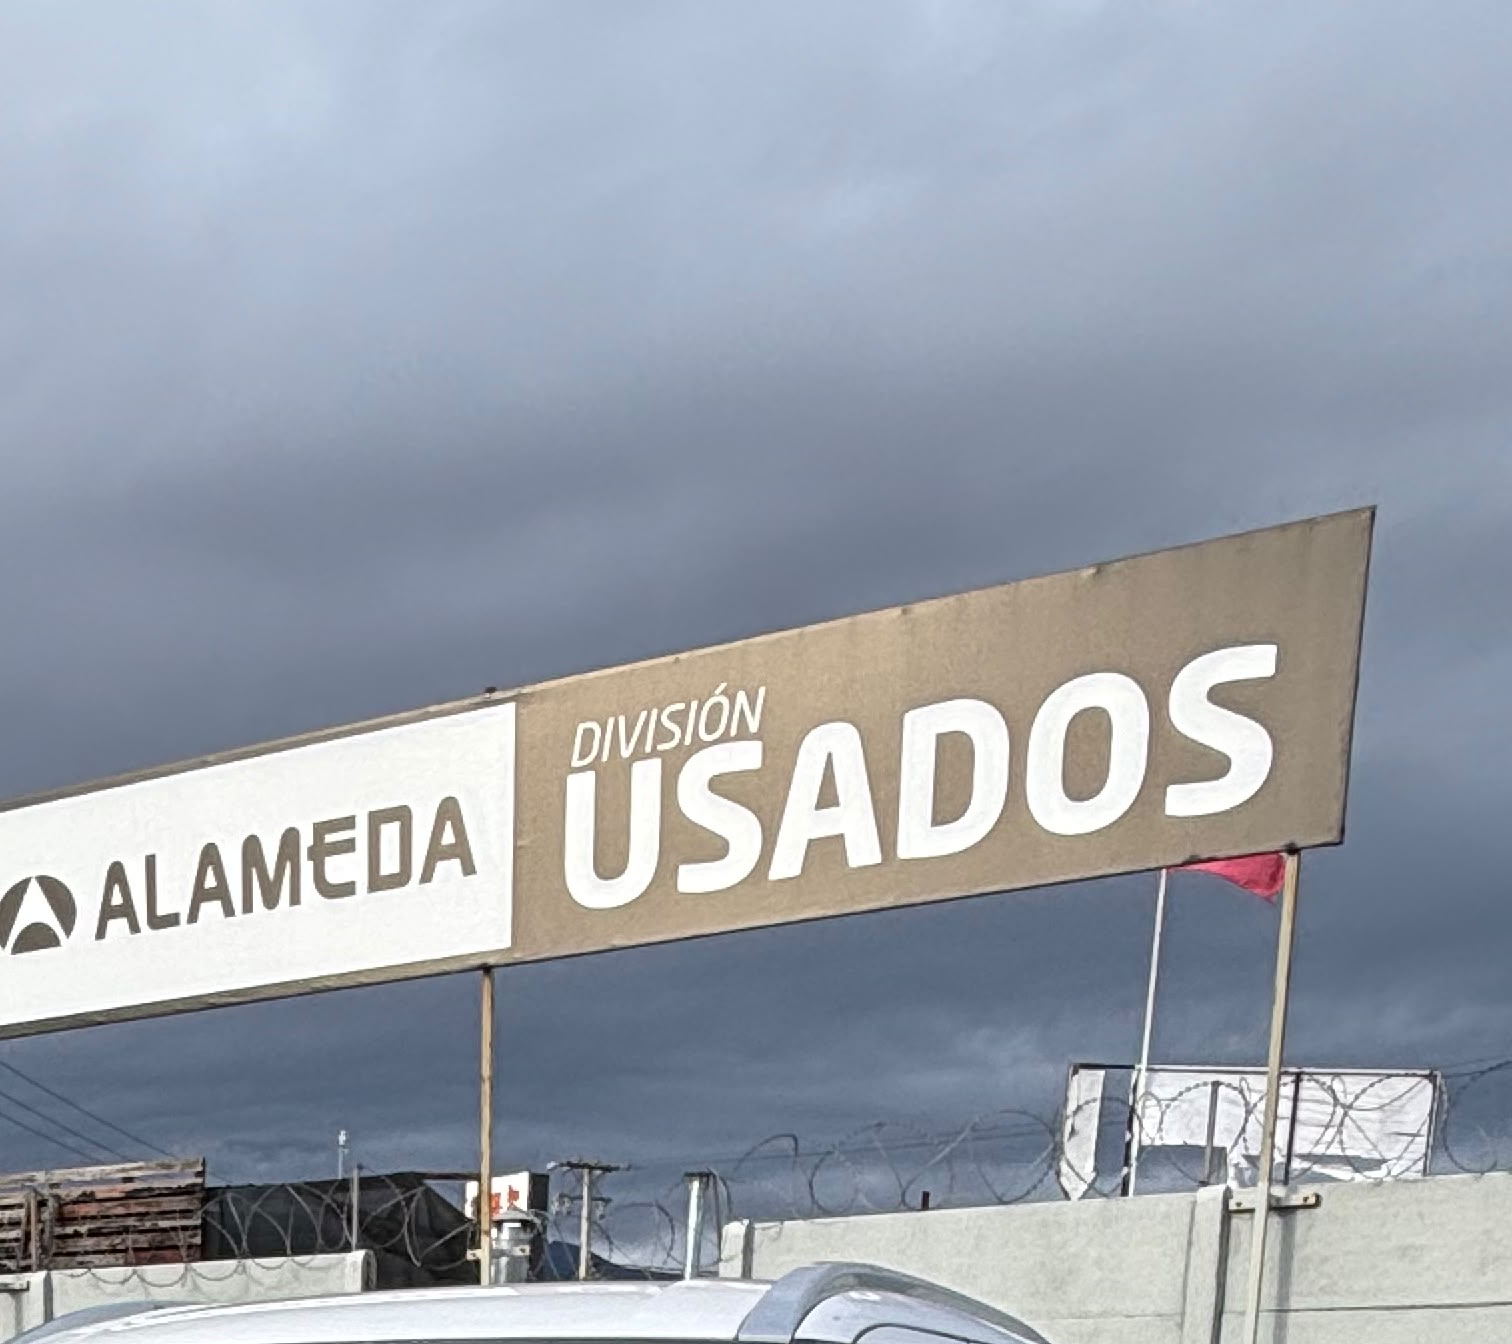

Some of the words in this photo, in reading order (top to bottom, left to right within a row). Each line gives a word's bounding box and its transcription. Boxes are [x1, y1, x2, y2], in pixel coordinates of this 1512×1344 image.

[563, 643, 1278, 909] USADOS
[570, 682, 766, 768] DIVISIÓN
[94, 796, 478, 941] ALAMEDA
